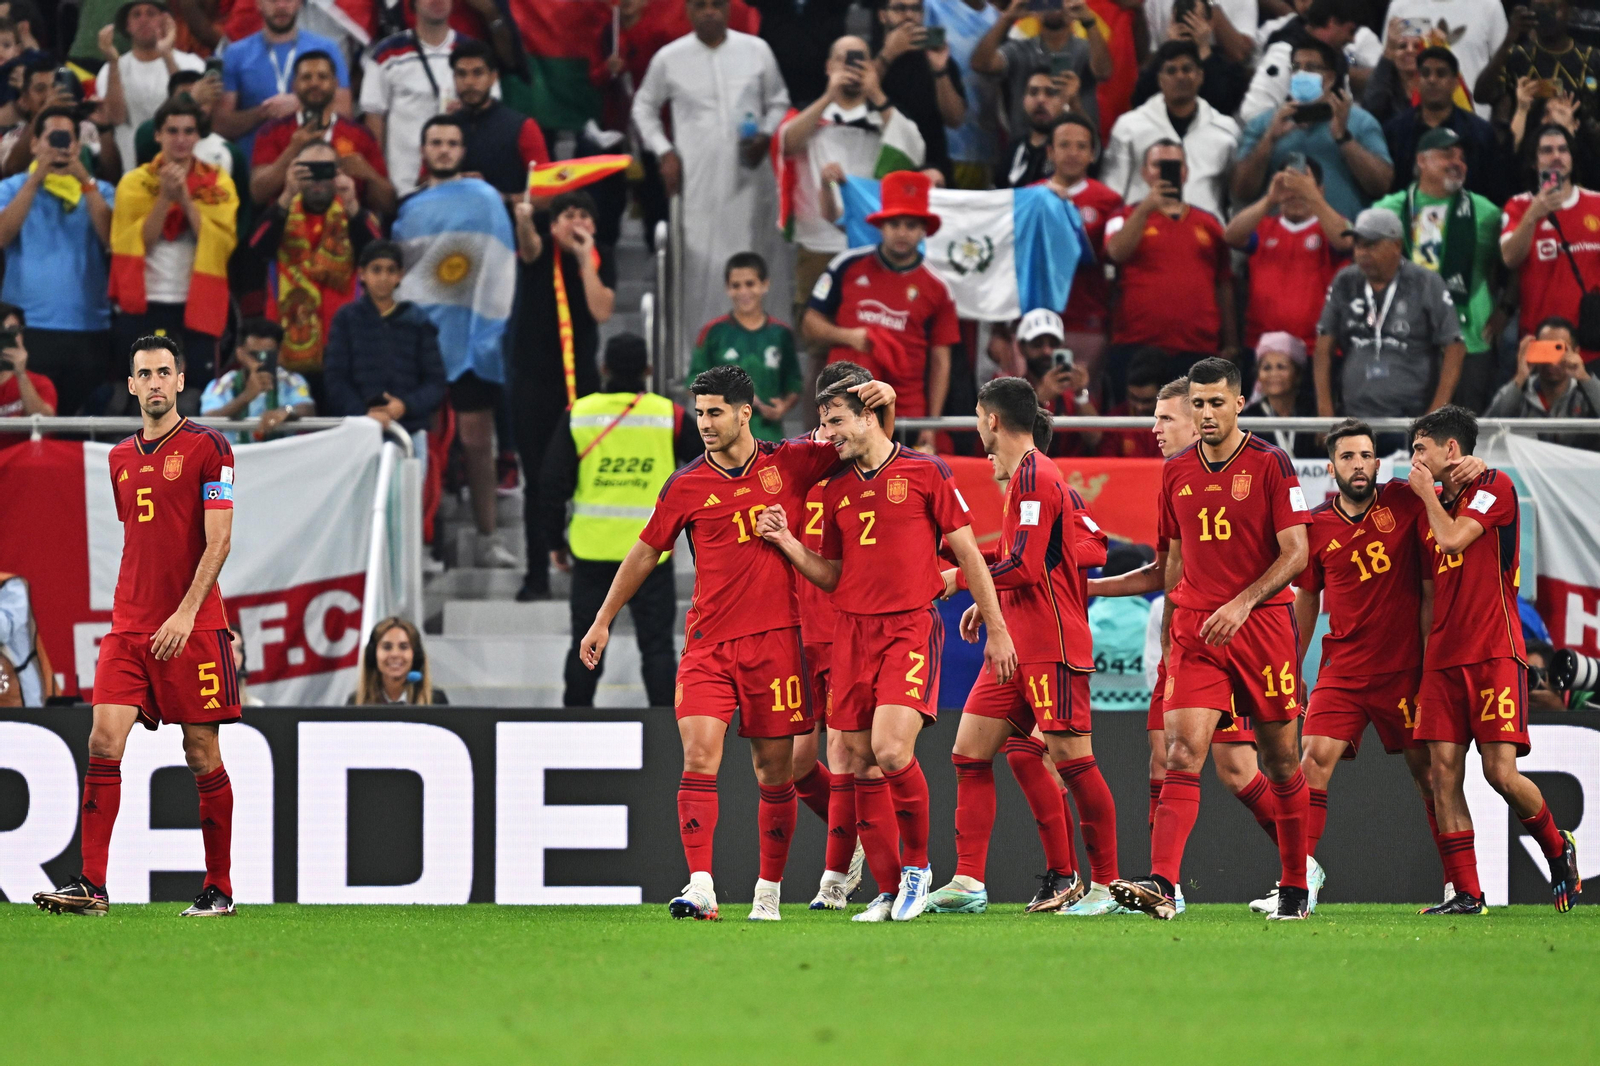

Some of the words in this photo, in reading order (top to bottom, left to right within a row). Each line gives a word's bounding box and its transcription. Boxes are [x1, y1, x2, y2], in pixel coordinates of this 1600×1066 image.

[594, 475, 648, 489] Security
[598, 457, 655, 473] 2226
[137, 487, 154, 522] 5
[859, 510, 876, 546] 2
[1198, 506, 1231, 541] 16
[1350, 540, 1391, 582] 18
[198, 662, 220, 696] 5
[905, 651, 925, 686] 2
[1262, 661, 1295, 697] 16
[770, 675, 802, 712] 10
[1029, 674, 1052, 708] 11
[1480, 686, 1516, 722] 26
[1397, 697, 1420, 729] 1
